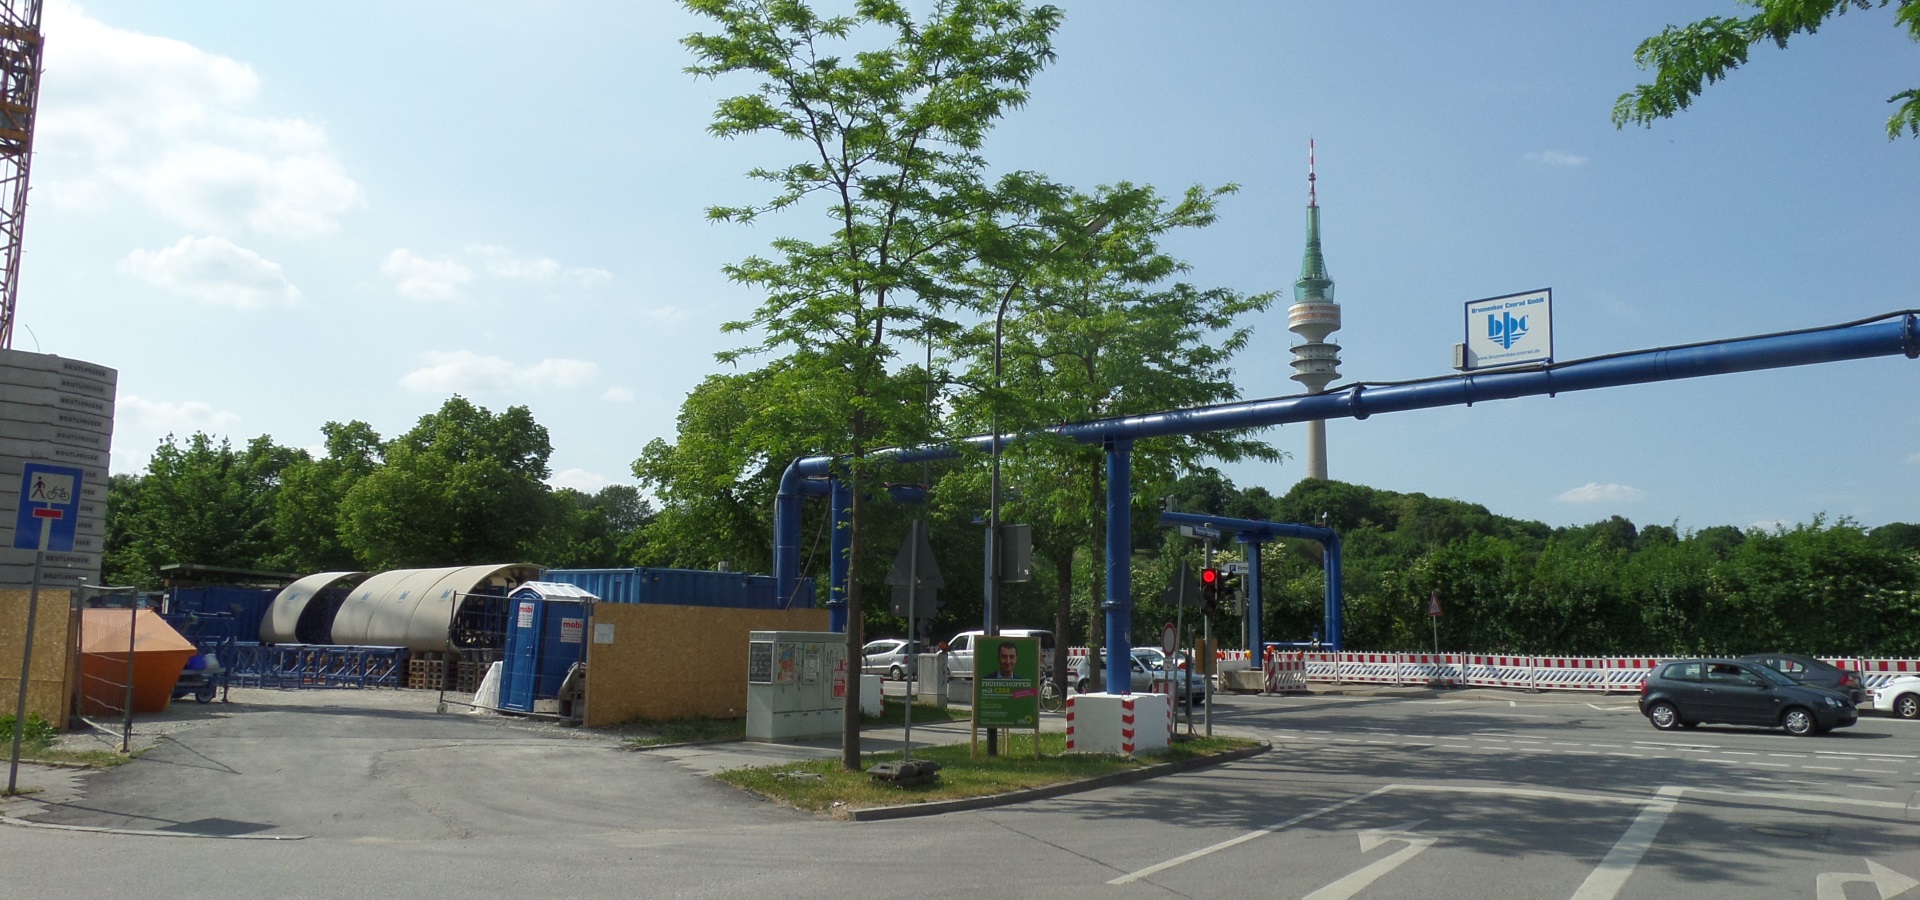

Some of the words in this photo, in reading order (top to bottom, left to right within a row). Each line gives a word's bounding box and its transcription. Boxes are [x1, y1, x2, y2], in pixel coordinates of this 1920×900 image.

[1471, 304, 1503, 314] Brunnenbau
[1504, 301, 1526, 309] Conrad
[1527, 297, 1544, 305] GmbH
[519, 605, 533, 614] mobi
[563, 621, 582, 629] mobi
